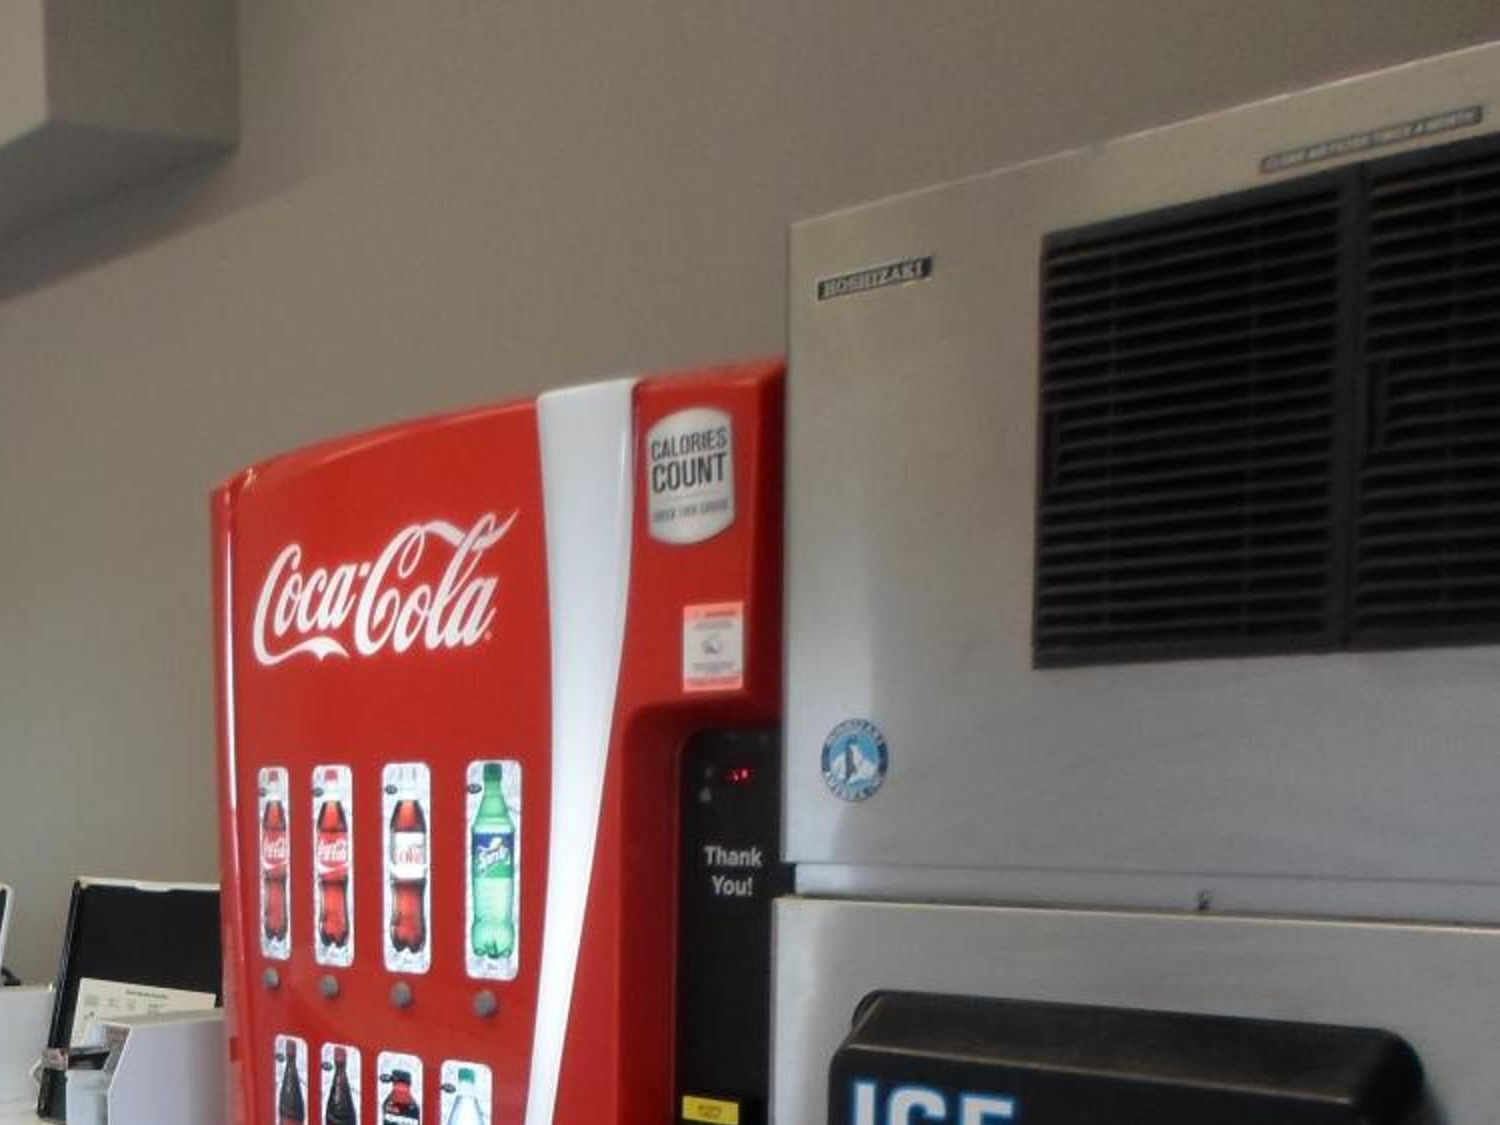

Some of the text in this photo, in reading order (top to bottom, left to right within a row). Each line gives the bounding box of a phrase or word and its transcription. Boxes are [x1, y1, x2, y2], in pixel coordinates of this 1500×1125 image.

[651, 426, 727, 461] CALORIES
[653, 452, 727, 494] COUNT
[253, 509, 519, 666] Coca-Cola
[704, 845, 763, 867] Thank
[711, 875, 754, 896] You!
